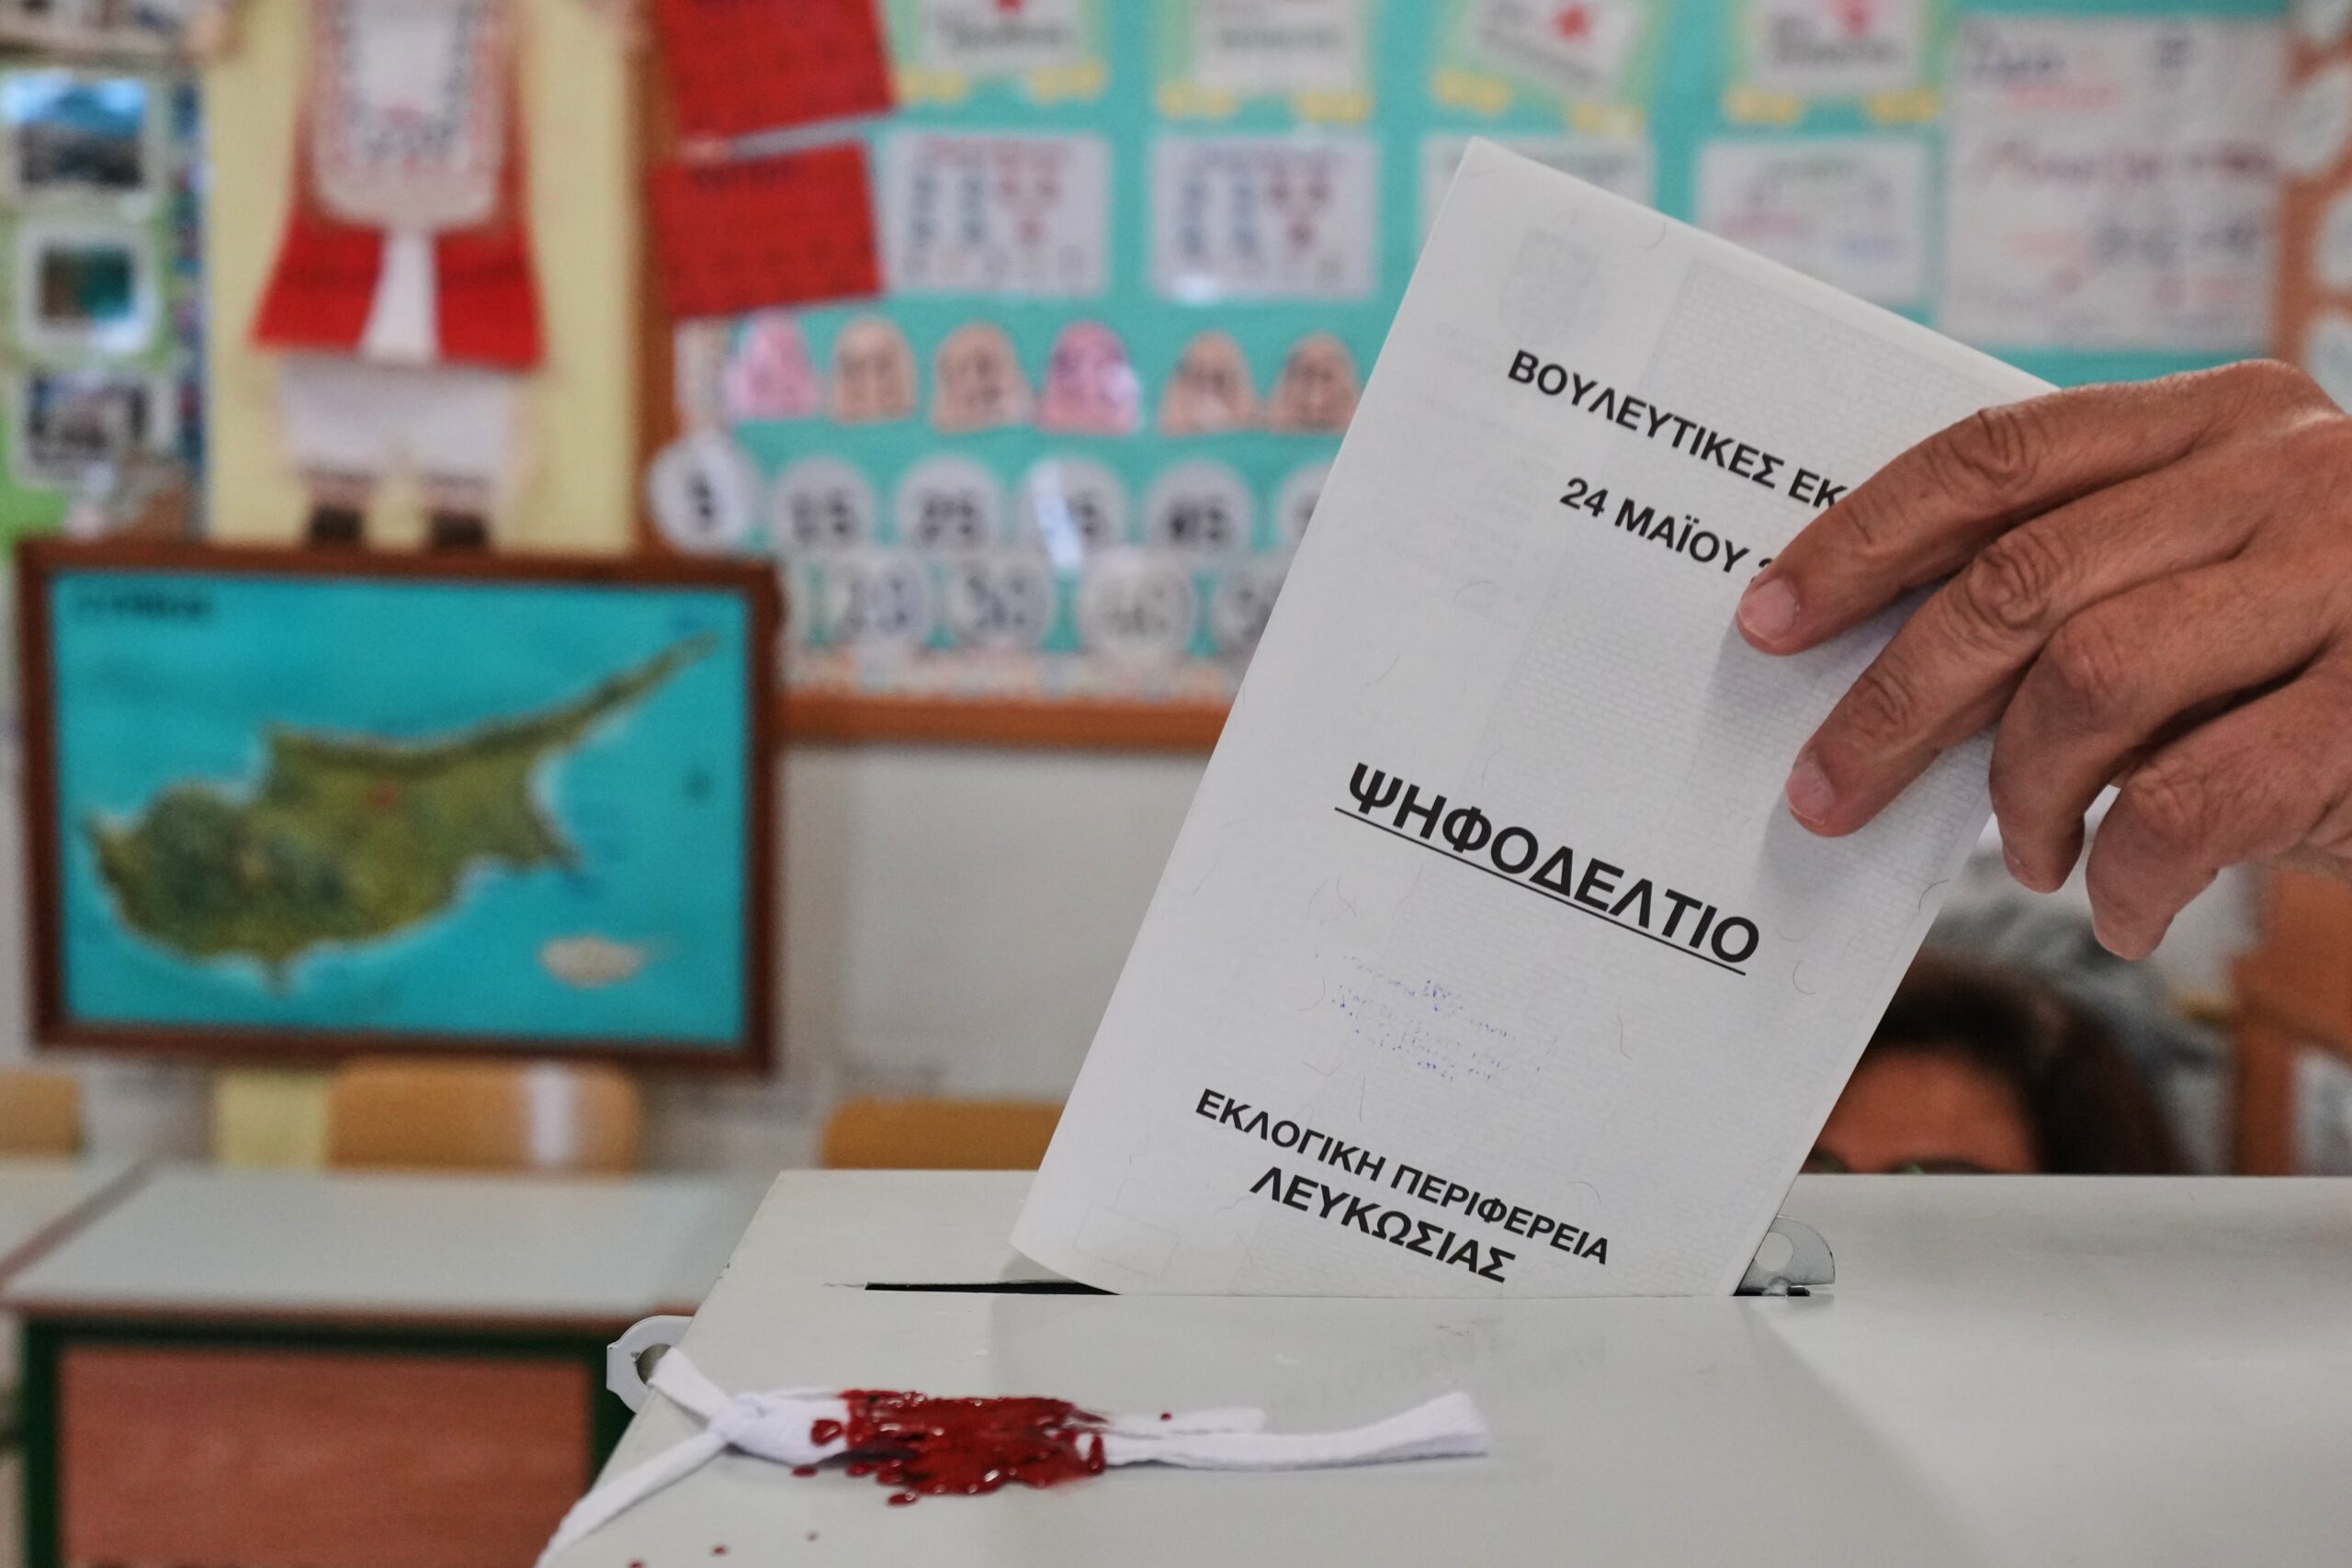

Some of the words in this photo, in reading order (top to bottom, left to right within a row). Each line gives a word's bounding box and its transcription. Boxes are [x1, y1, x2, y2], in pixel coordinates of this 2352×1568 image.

[1508, 349, 1785, 490] ΒΟΥΛΕΥΤΙΚΕΣ
[1788, 467, 1848, 510] ΕΚ
[1559, 477, 1609, 518] 24
[1614, 497, 1751, 573] ΜΑΪΟΥ
[1349, 761, 1759, 964] ΨΗΦΟΔΕΛΤΙΟ
[1195, 1088, 1386, 1182] ΕΚΛΟΓΙΚΗ
[1390, 1164, 1609, 1266] ΠΕΡΙΦΕΡΕΙΑ
[1249, 1167, 1517, 1282] ΛΕΥΚΩΣΙΑΣ
